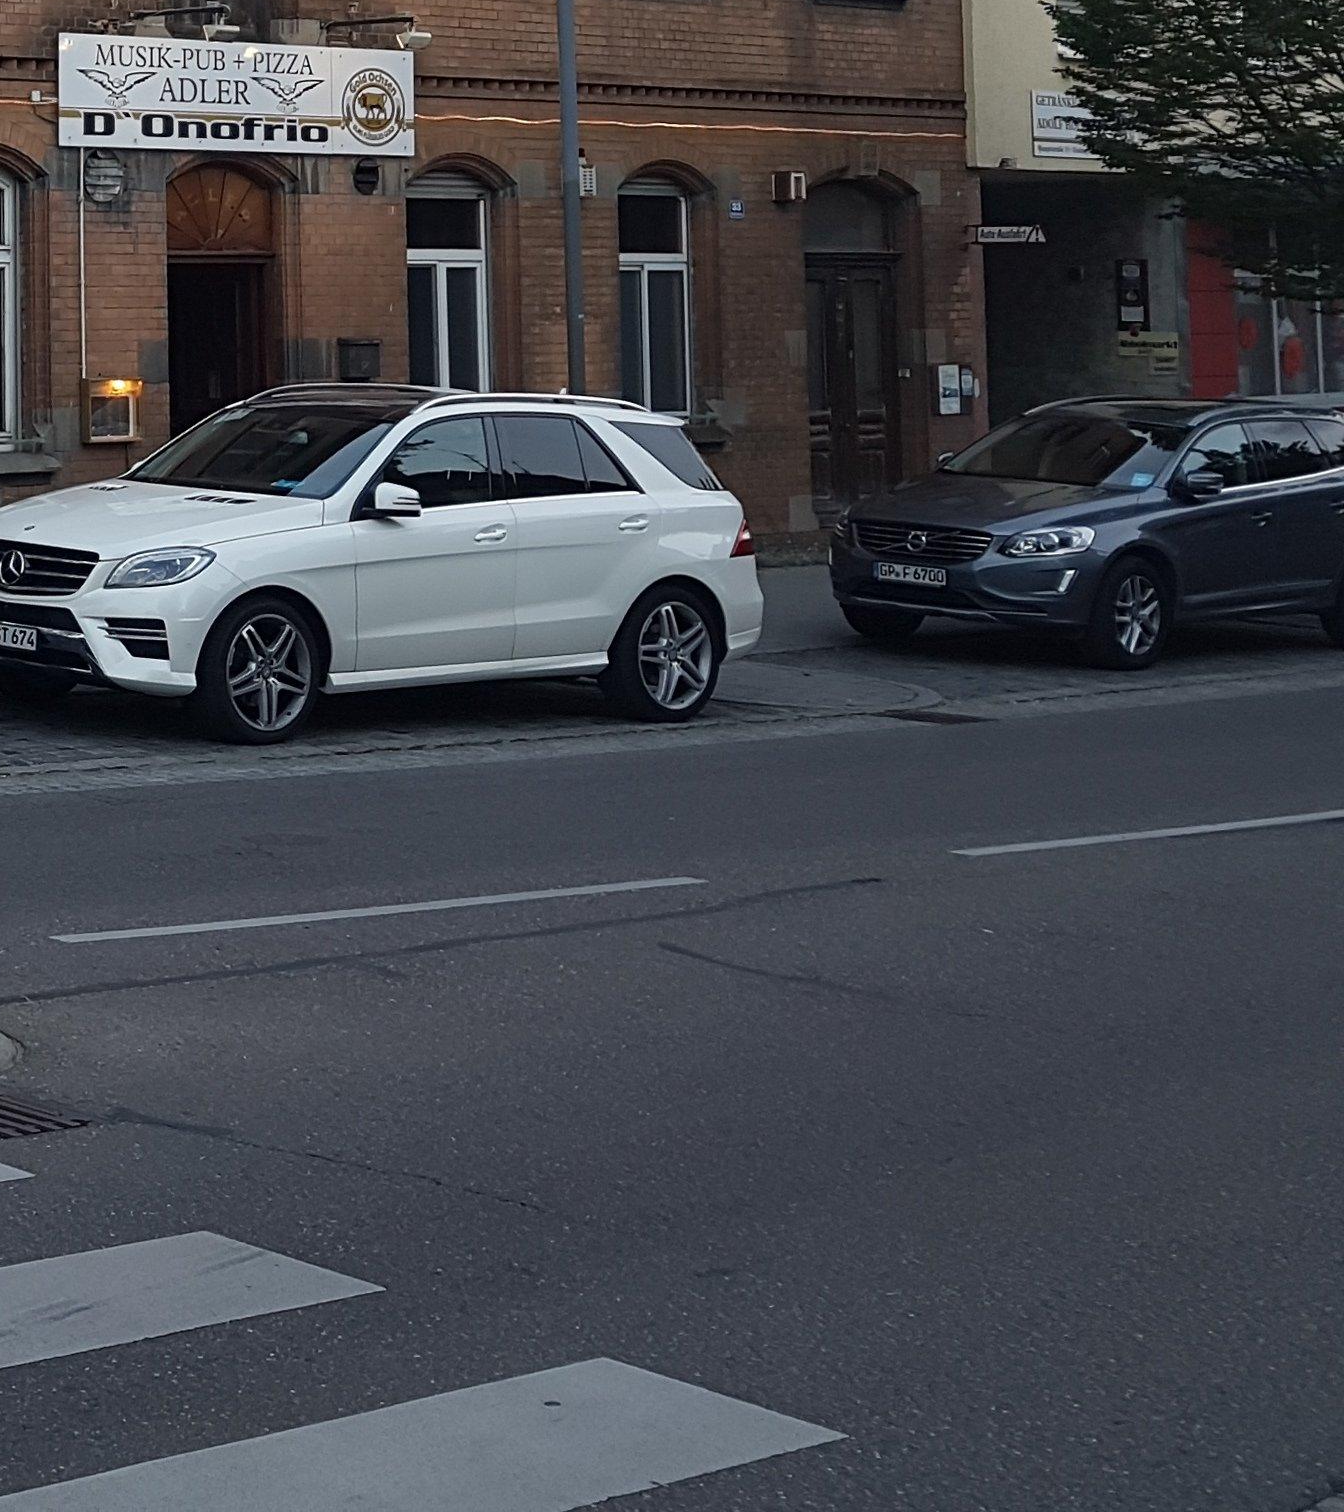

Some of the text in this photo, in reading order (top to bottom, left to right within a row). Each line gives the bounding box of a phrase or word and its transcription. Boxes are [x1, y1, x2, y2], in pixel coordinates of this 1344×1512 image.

[94, 43, 315, 76] MUSIK-PUB + PIZZA
[158, 76, 252, 105] ADLER
[349, 72, 397, 96] Gold Ochsen
[879, 563, 944, 583] GP F 6700
[11, 628, 36, 648] 674
